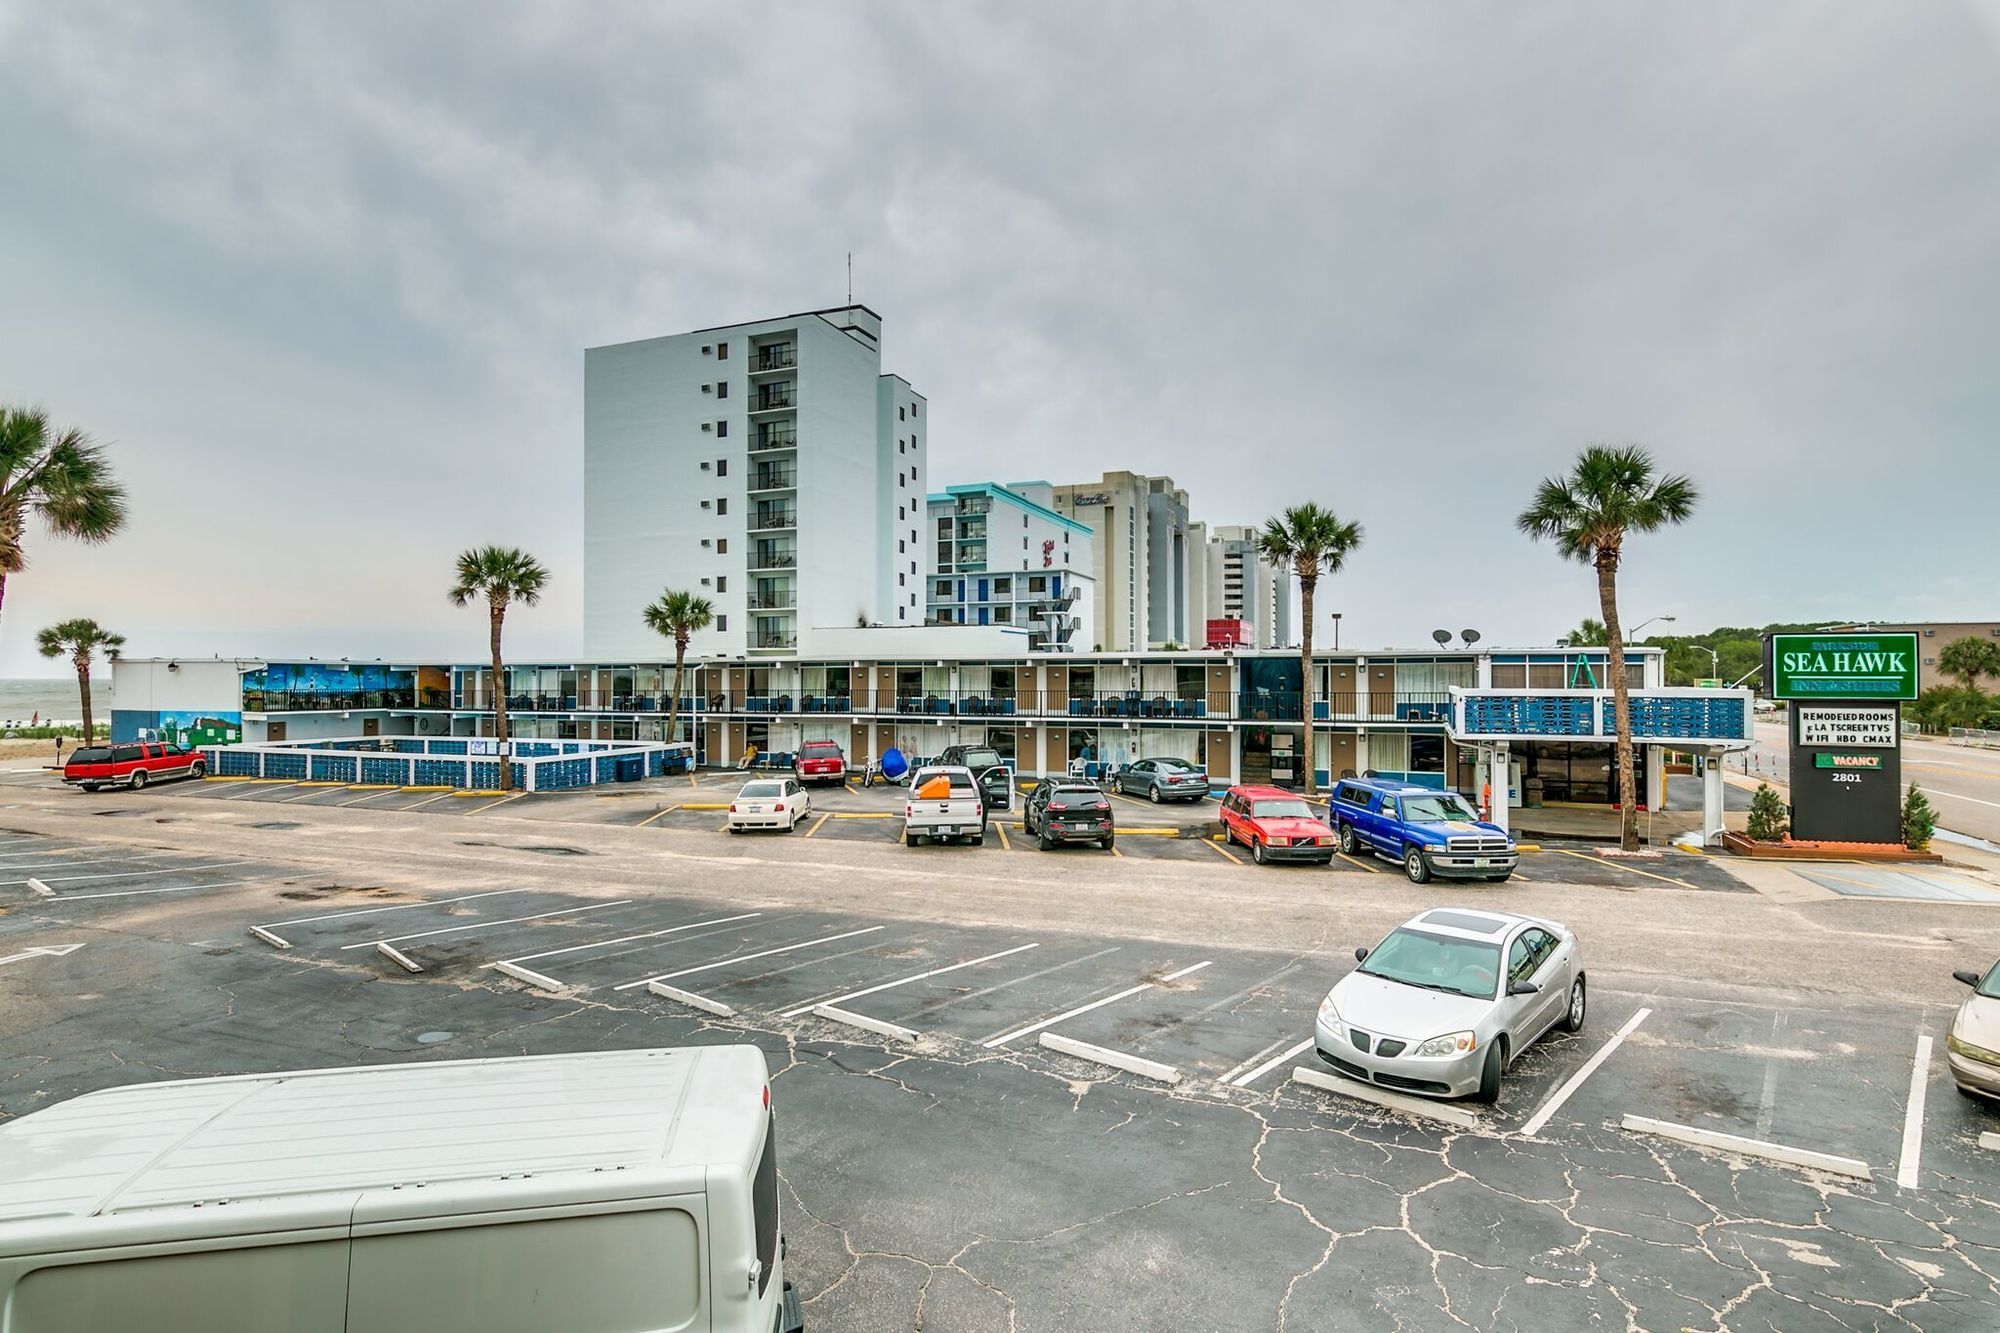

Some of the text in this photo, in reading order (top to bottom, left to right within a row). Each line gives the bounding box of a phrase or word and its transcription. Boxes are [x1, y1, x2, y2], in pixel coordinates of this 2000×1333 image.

[1783, 652, 1907, 672] SEA HAWK
[1871, 724, 1890, 732] TVS
[1806, 734, 1892, 743] WIFI HBO CMAX
[1833, 756, 1879, 766] VACANCY
[1832, 773, 1861, 782] 2801
